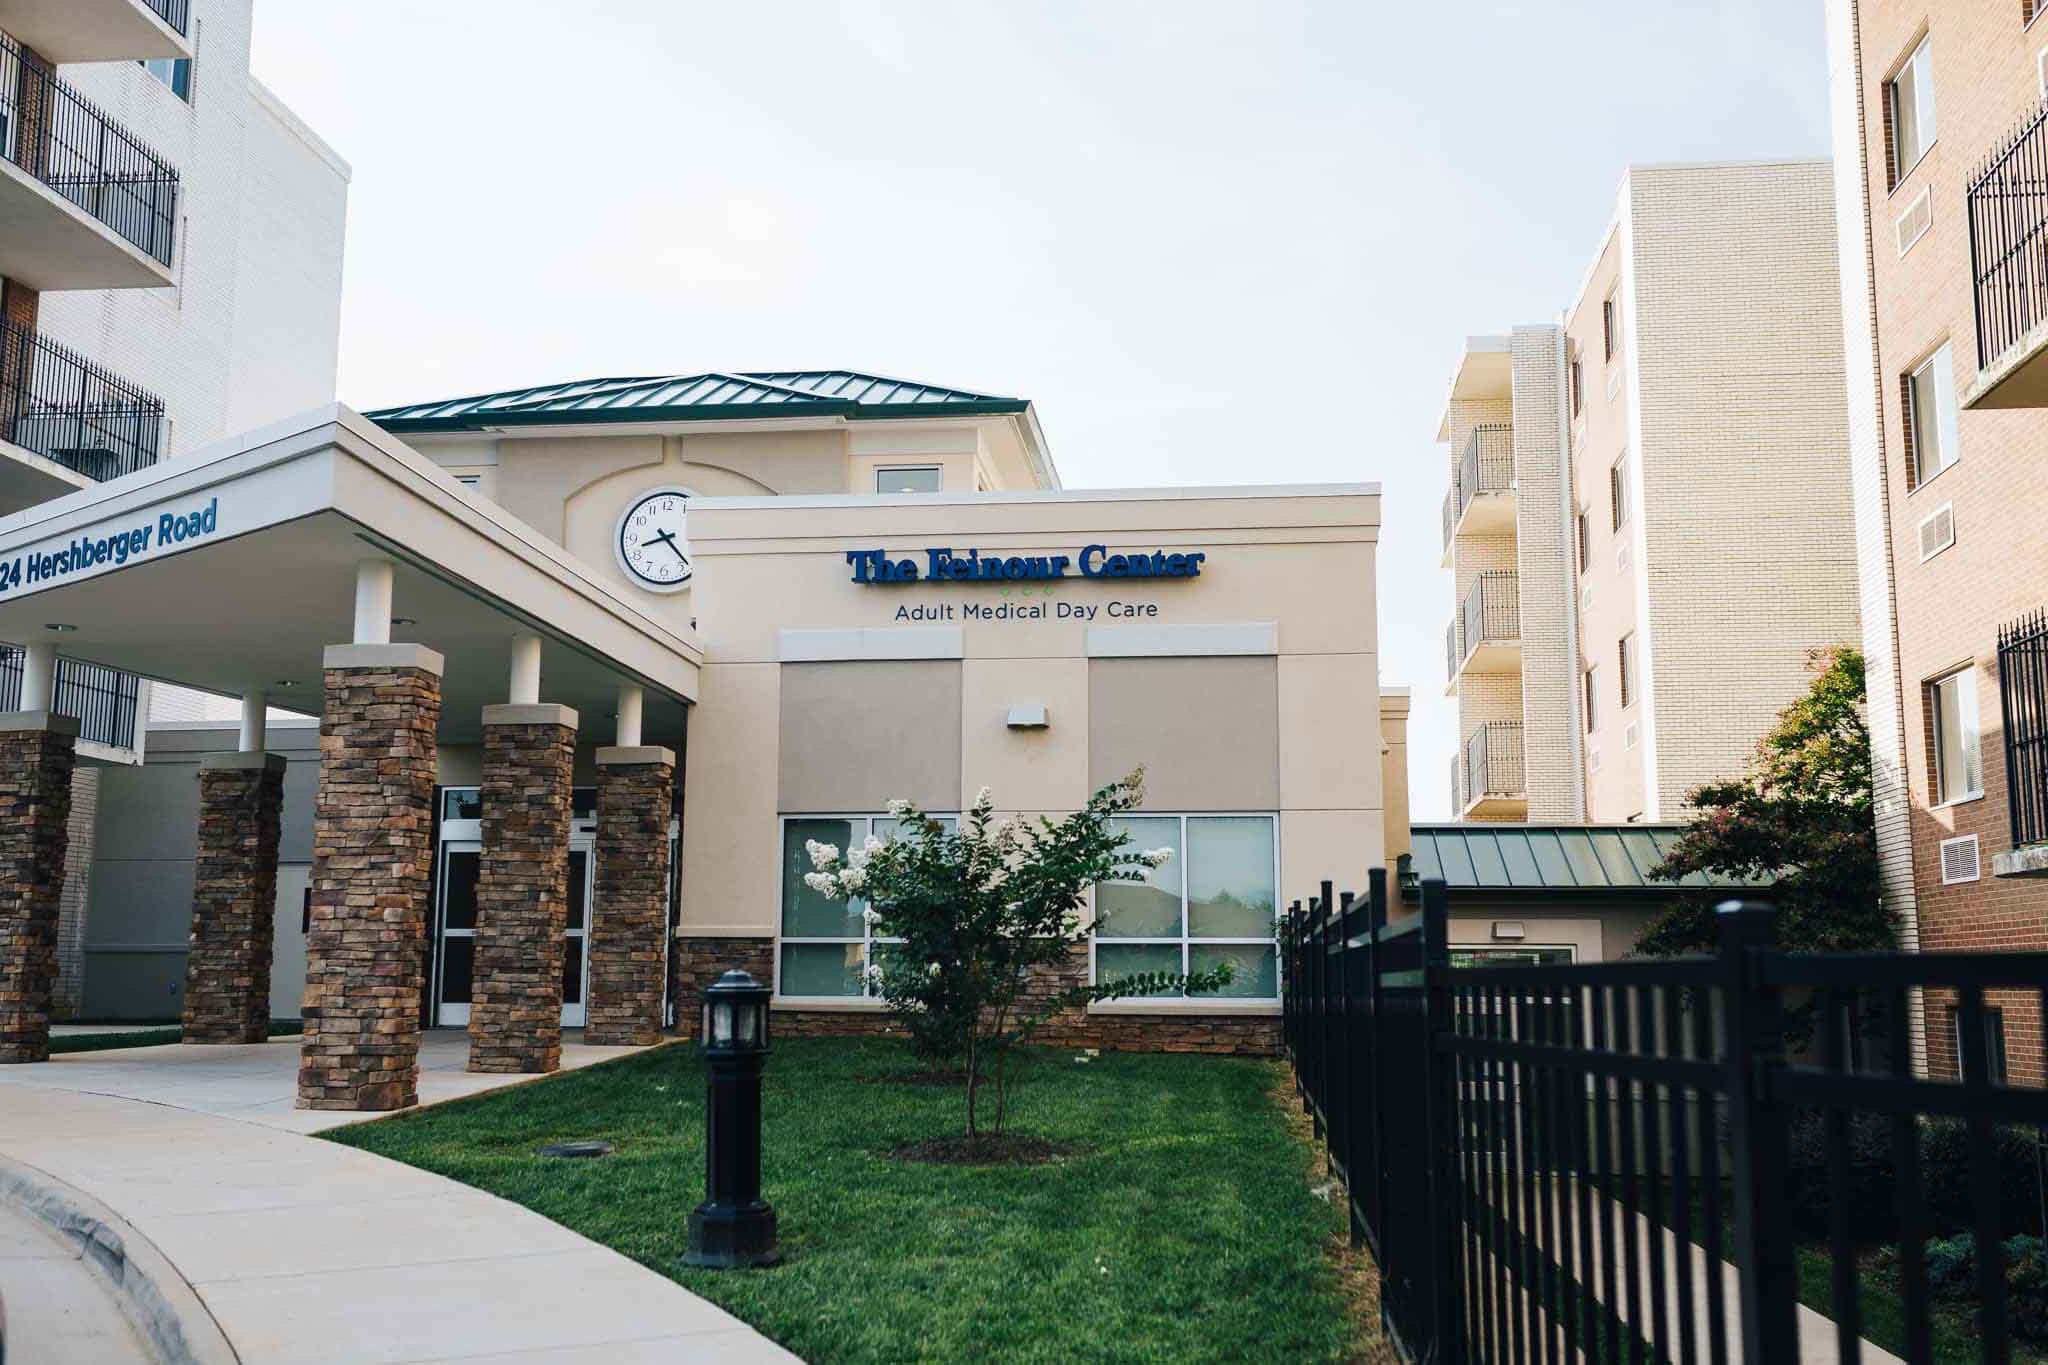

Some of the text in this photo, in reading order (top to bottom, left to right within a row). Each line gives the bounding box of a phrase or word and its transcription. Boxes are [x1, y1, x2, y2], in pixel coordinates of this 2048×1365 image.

[649, 505, 656, 516] 11
[662, 500, 674, 511] 12
[636, 516, 647, 526] 10
[26, 525, 152, 583] Hershberger
[157, 496, 218, 546] Road
[629, 533, 638, 545] 9
[632, 550, 642, 561] 8
[646, 560, 654, 572] 7
[846, 544, 1206, 584] The Feinour Center
[659, 565, 669, 577] 6
[895, 601, 1159, 621] Adult Medical Day Care
